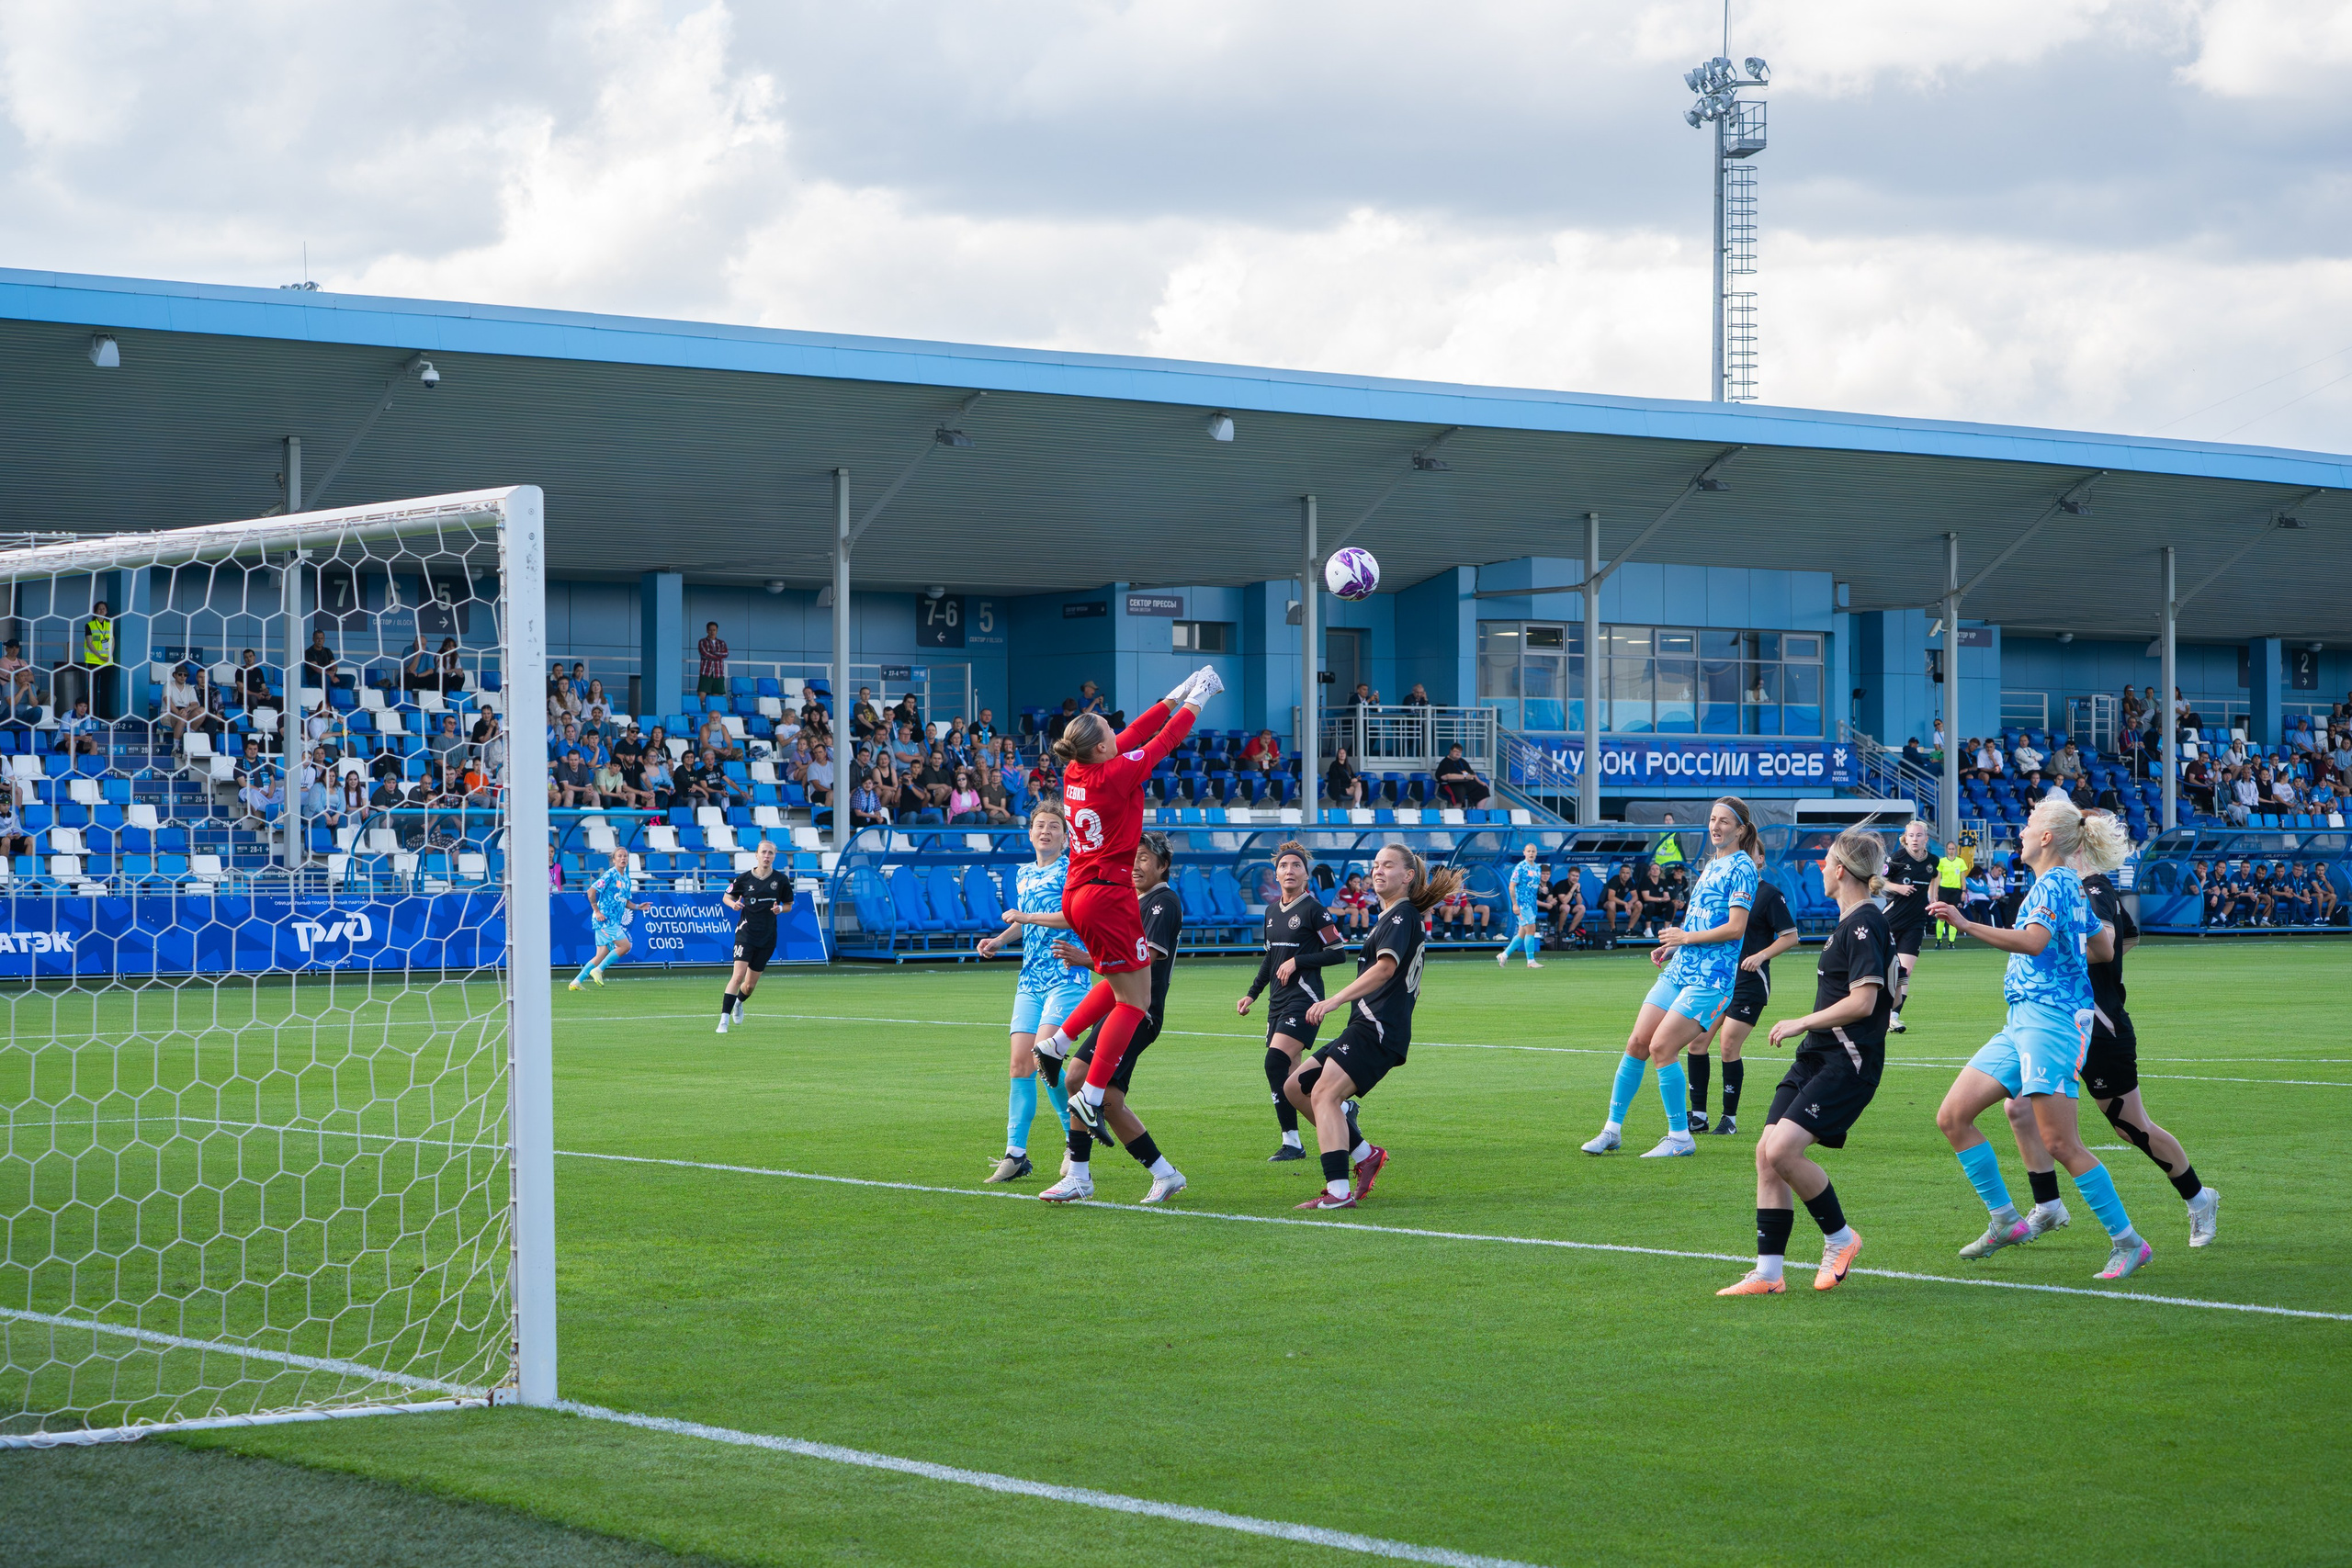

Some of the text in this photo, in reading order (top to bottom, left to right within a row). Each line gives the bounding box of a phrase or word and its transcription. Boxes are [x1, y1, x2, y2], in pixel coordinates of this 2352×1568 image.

[334, 580, 349, 607] 7
[385, 581, 401, 614] 6
[436, 582, 451, 611] 5
[1129, 598, 1176, 608] СЕКТОР ПРЕССЫ
[924, 600, 958, 627] 7-6
[979, 602, 993, 632] 5
[2301, 653, 2309, 673] 2
[1646, 751, 1749, 776] РОССИИ
[1758, 752, 1825, 776] 2026
[643, 903, 725, 919] РОССИЙСКИЙ
[645, 919, 732, 933] ФУТБОЛЬНЫЙ
[648, 937, 684, 949] СОЮЗ
